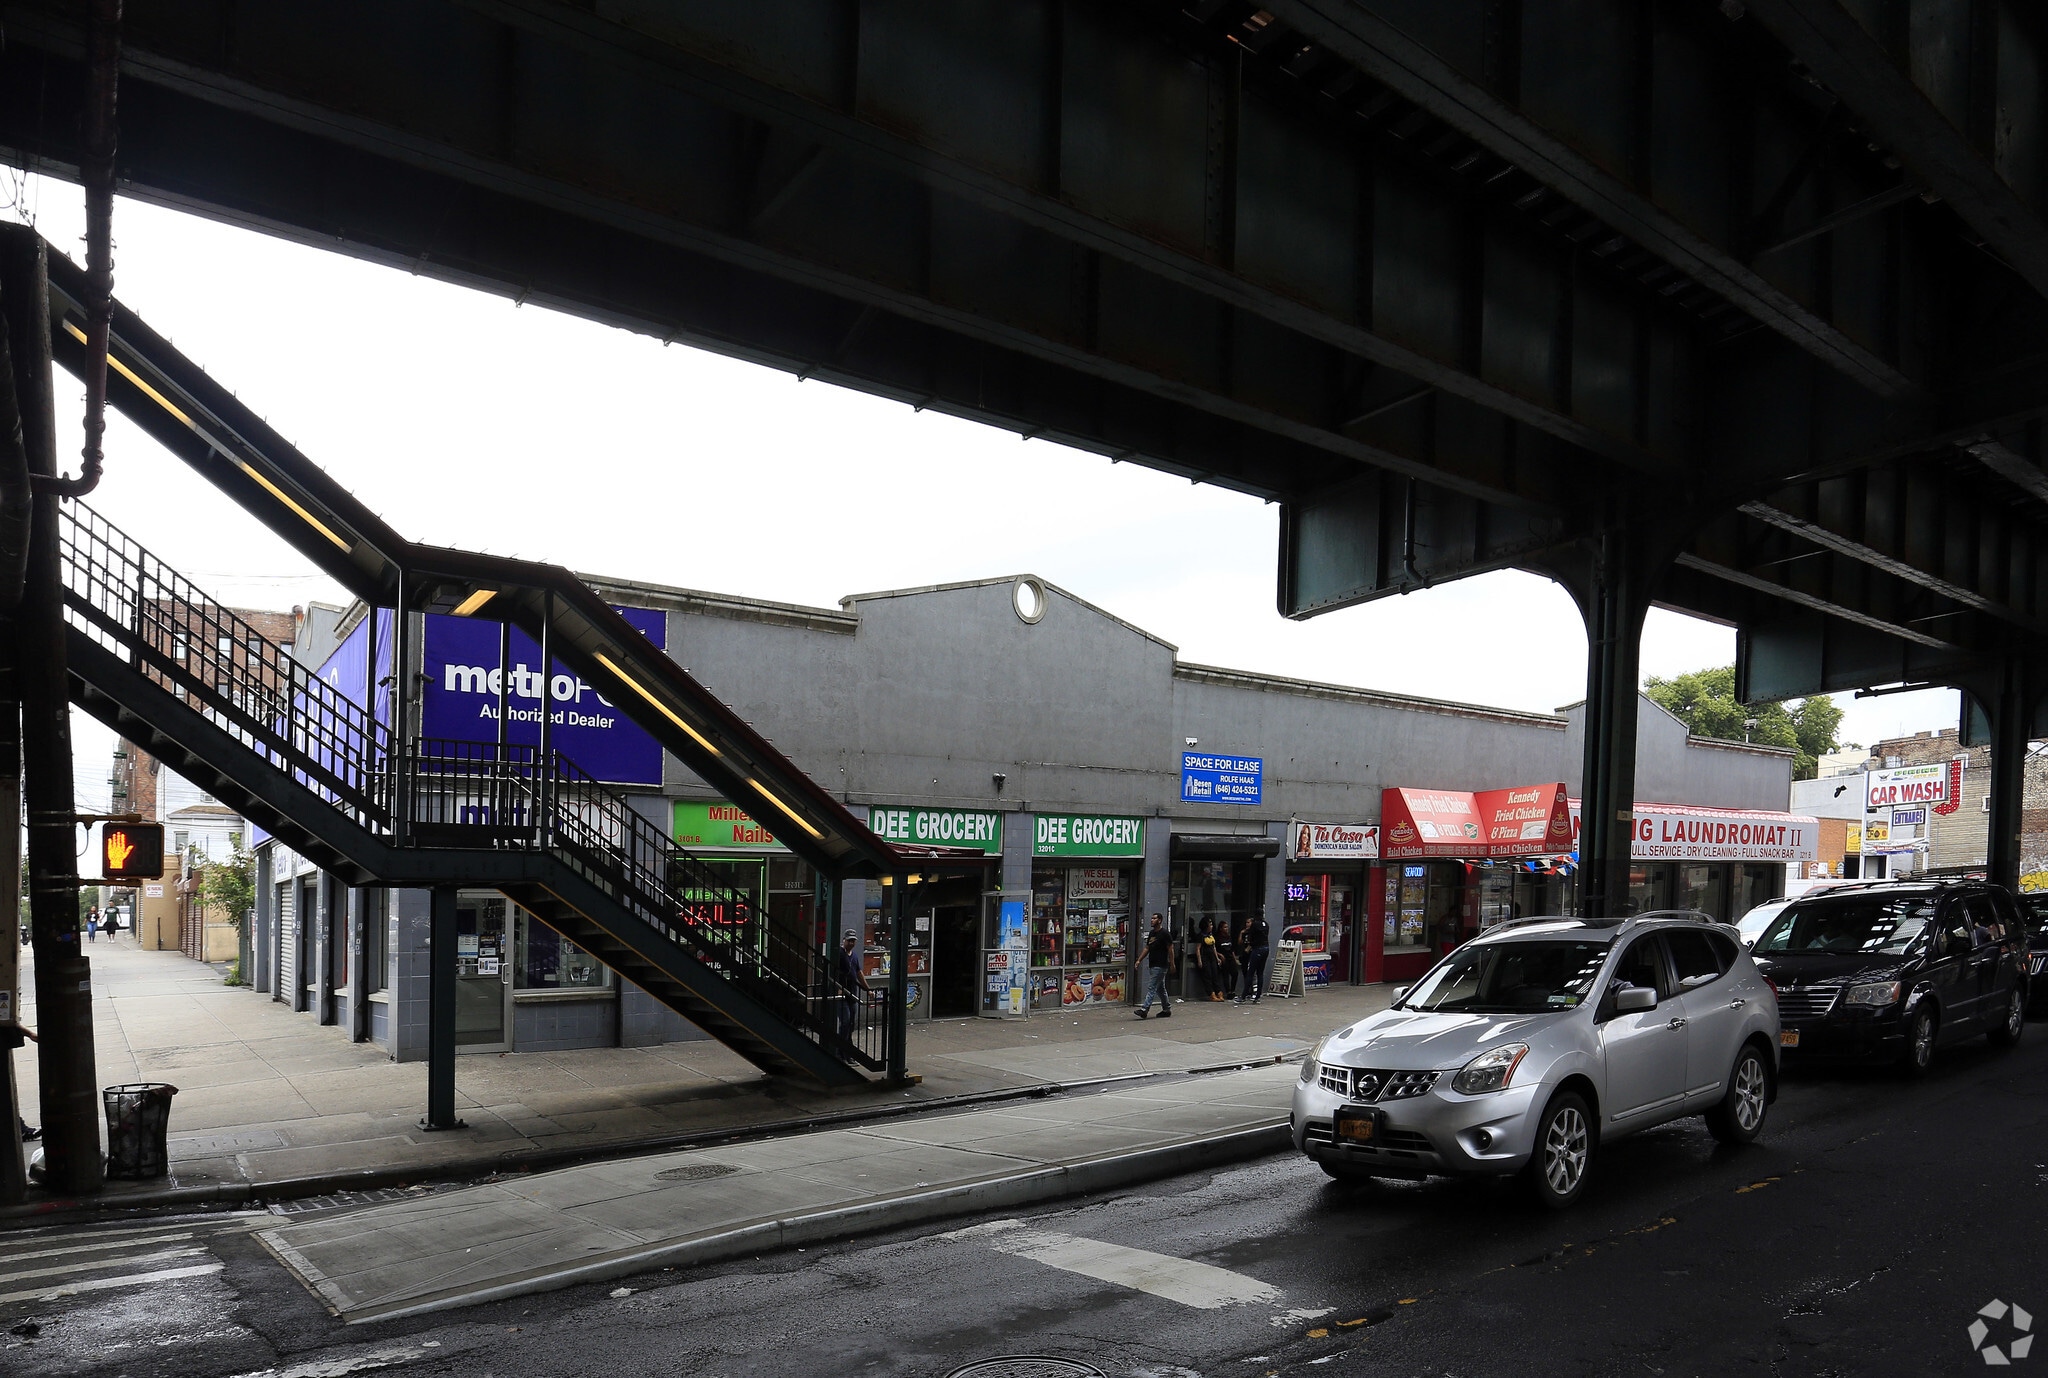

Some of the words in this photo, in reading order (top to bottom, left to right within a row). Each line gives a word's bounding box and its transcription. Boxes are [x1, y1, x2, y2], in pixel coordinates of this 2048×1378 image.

[444, 663, 614, 708] metroP
[479, 703, 564, 724] Auhorized
[568, 711, 615, 728] Dealer
[1185, 756, 1213, 768] SPACE
[1215, 759, 1232, 770] FOR
[1234, 761, 1259, 772] LEASE
[1220, 775, 1238, 783] ROLFE
[1193, 786, 1212, 795] Retail
[1215, 784, 1231, 795] (646)
[1231, 785, 1258, 795] 424-5321
[1508, 789, 1541, 804] Kennedy
[1870, 785, 1897, 805] CAR
[1901, 781, 1944, 802] WASH
[708, 806, 753, 821] Mille
[1494, 808, 1515, 822] Fried
[1515, 807, 1546, 821] Chicken
[1894, 811, 1923, 825] ENTRANCE
[874, 810, 910, 839] DEE
[915, 811, 997, 840] GROCERY
[1037, 817, 1068, 843] DEE
[1072, 818, 1140, 844] GROCERY
[677, 834, 694, 843] 3101
[733, 824, 774, 843] Nails
[1314, 825, 1331, 843] Tu
[1331, 826, 1364, 844] Casa
[1498, 826, 1519, 839] Pizza
[1661, 820, 1785, 846] LAUNDROMAT
[1790, 829, 1802, 847] II
[1387, 847, 1400, 857] Halal
[1401, 845, 1423, 857] Chicken
[1490, 845, 1510, 855] Halal
[1511, 843, 1543, 855] Chicken
[1649, 845, 1682, 857] SERVICE
[1686, 846, 1701, 858] DRY
[1703, 847, 1738, 858] CLEANING
[1742, 848, 1757, 858] FULL
[1759, 849, 1779, 859] SNACK
[1781, 850, 1795, 859] BAR
[1084, 869, 1096, 878] WE
[1096, 870, 1115, 879] SELL
[1405, 866, 1424, 877] SEAFOOD
[1084, 881, 1116, 889] HOOKAH
[995, 954, 1008, 963] NO
[988, 983, 1008, 992] EBT
